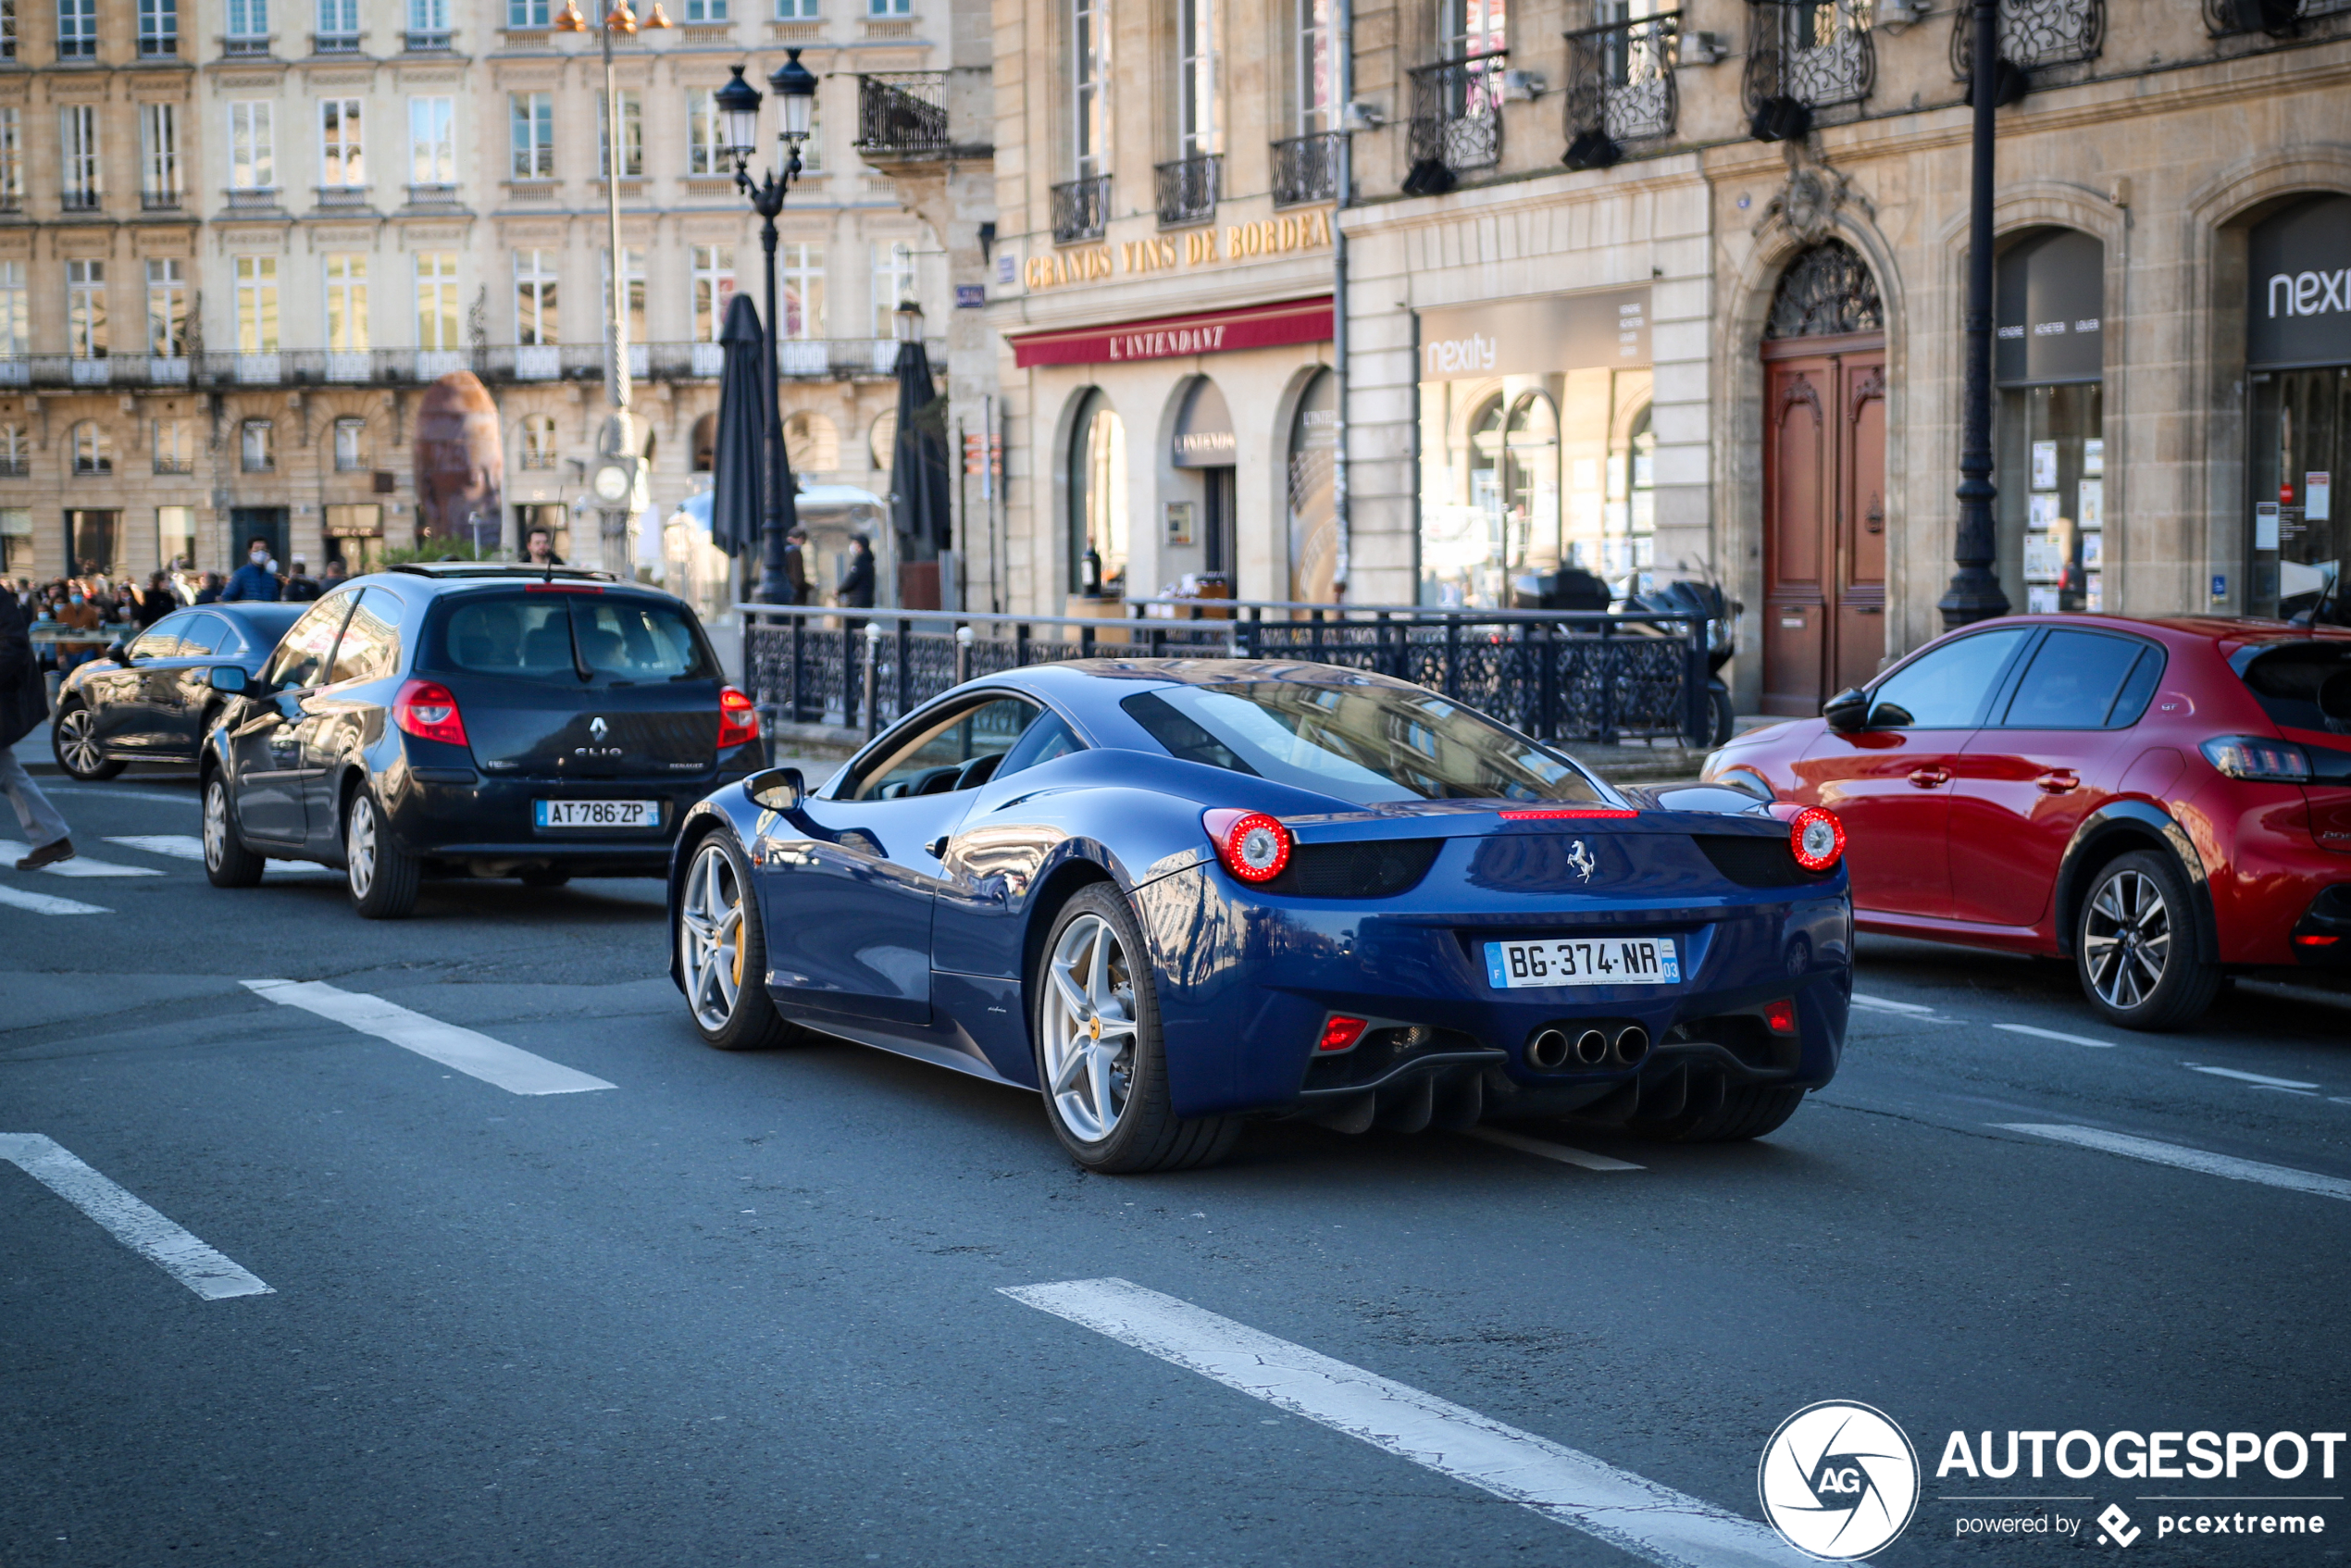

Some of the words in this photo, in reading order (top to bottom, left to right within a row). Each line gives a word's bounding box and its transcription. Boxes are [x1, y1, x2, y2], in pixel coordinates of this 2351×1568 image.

[1025, 245, 1112, 288] GRANDS
[1120, 234, 1176, 272] VINS
[1184, 228, 1218, 267] DE
[1110, 325, 1226, 361] L'INTENDANT
[2034, 321, 2066, 336] ACHETER
[2075, 317, 2099, 333] LOUER
[1427, 331, 1497, 374] nexity
[574, 747, 623, 757] CLIO
[551, 803, 644, 824] AT-786-ZP
[1493, 970, 1500, 979] F
[1508, 942, 1659, 978] BG-374-NR
[1662, 962, 1678, 977] 03
